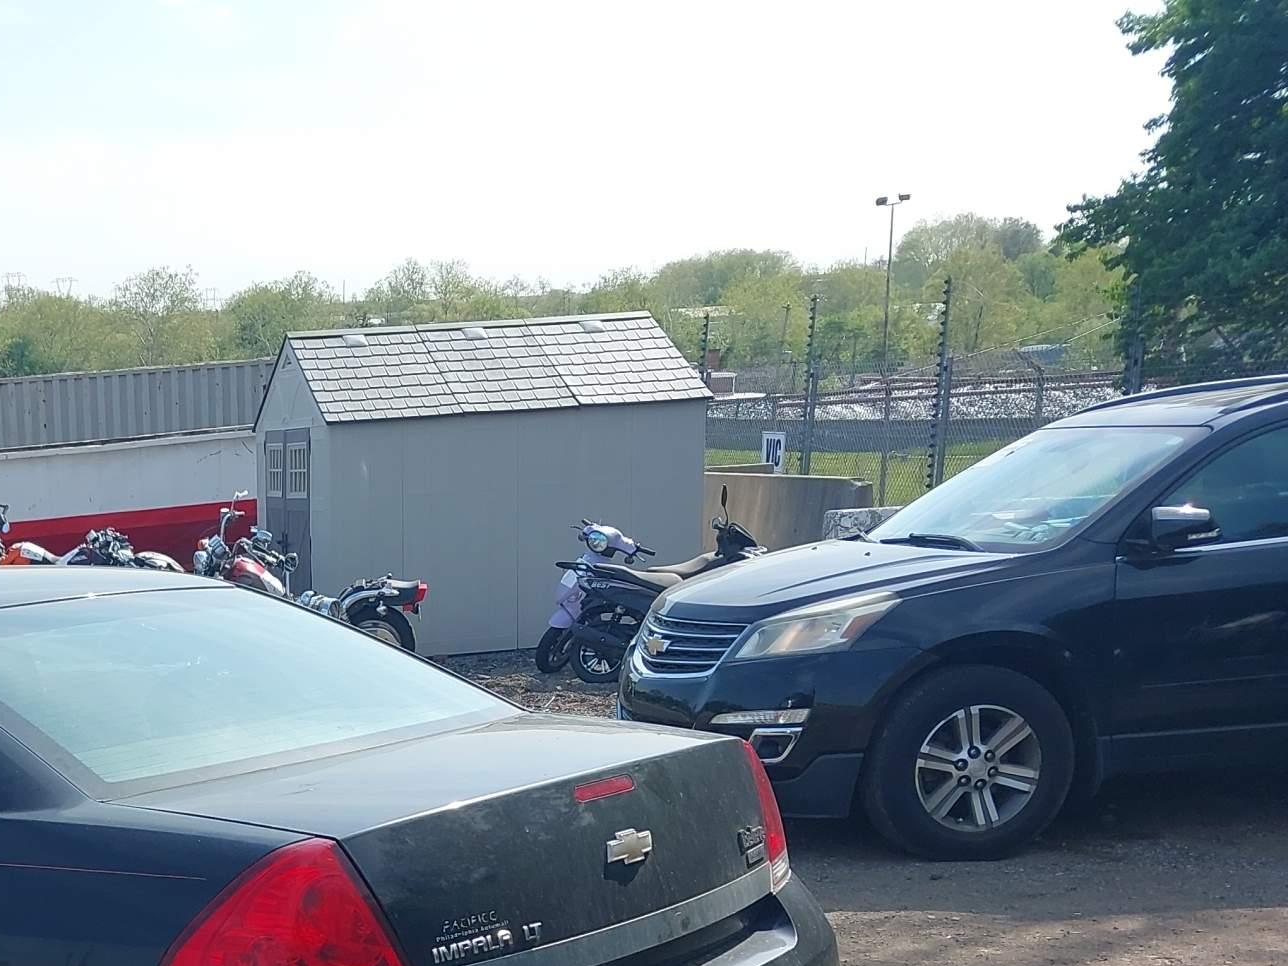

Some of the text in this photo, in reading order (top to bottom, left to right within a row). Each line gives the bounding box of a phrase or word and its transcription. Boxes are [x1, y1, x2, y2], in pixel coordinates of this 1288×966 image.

[765, 438, 782, 467] VIC
[431, 922, 543, 964] IMPALA LT
